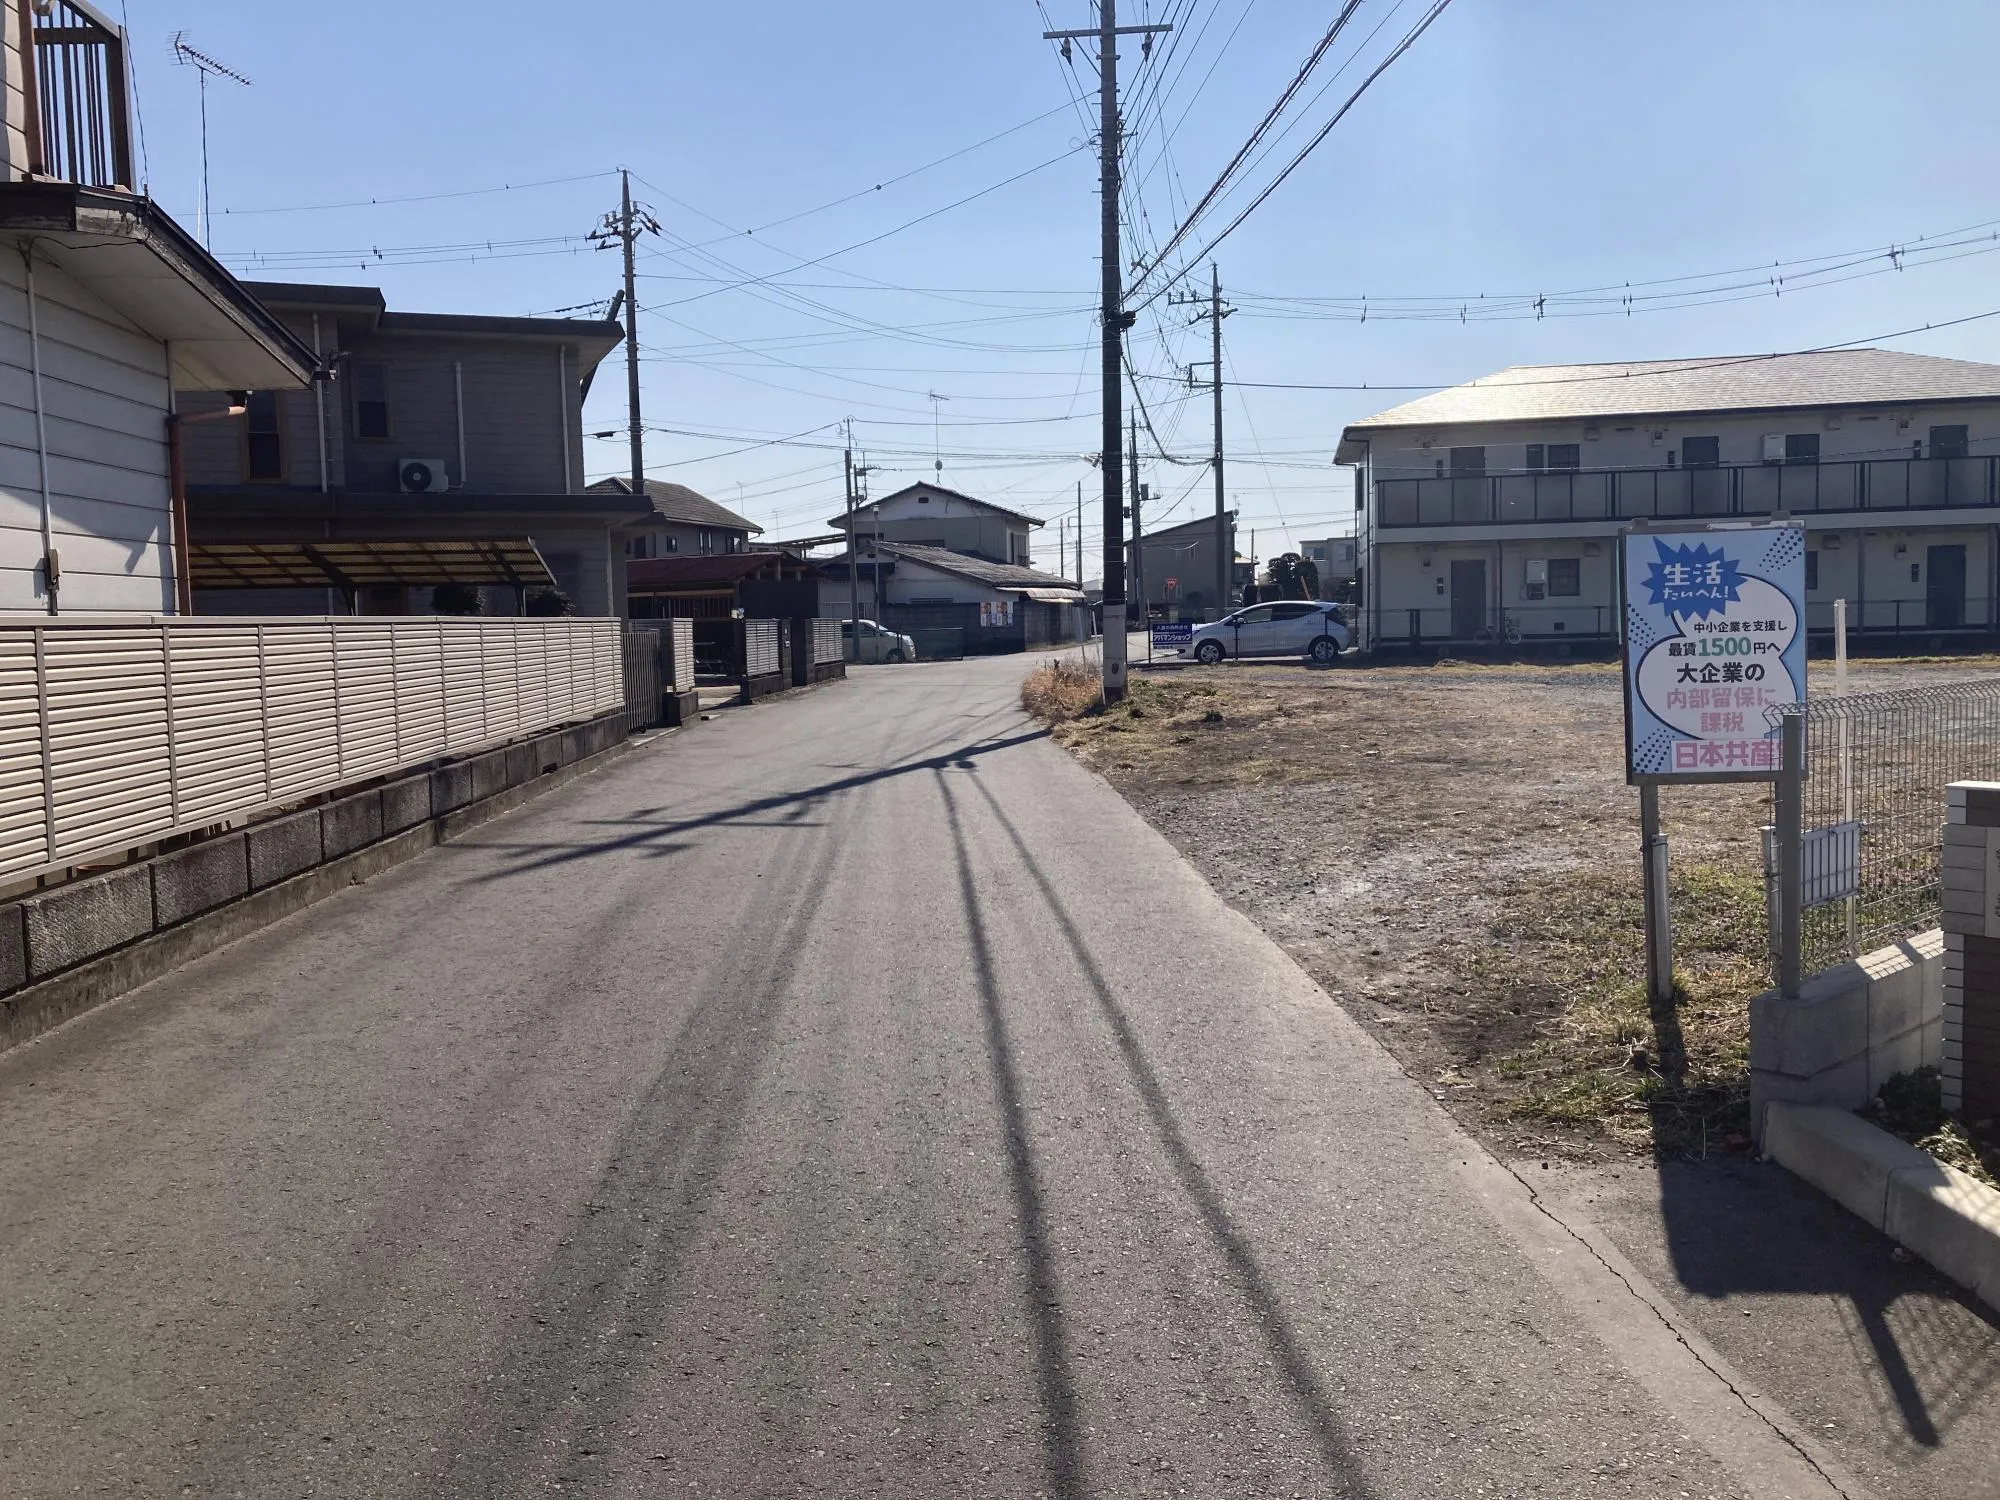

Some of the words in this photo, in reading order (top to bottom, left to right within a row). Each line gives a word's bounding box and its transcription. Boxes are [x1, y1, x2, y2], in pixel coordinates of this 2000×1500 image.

[1663, 560, 1724, 586] 生活
[1694, 620, 1787, 633] 中小企業を支援し
[1153, 633, 1191, 642] アパマンショップ
[1668, 637, 1781, 657] 最賃1500円へ
[1677, 662, 1765, 683] 大企業の
[1667, 687, 1775, 709] 内部留保に
[1700, 712, 1745, 733] 課税
[1676, 740, 1784, 768] 日本共産
